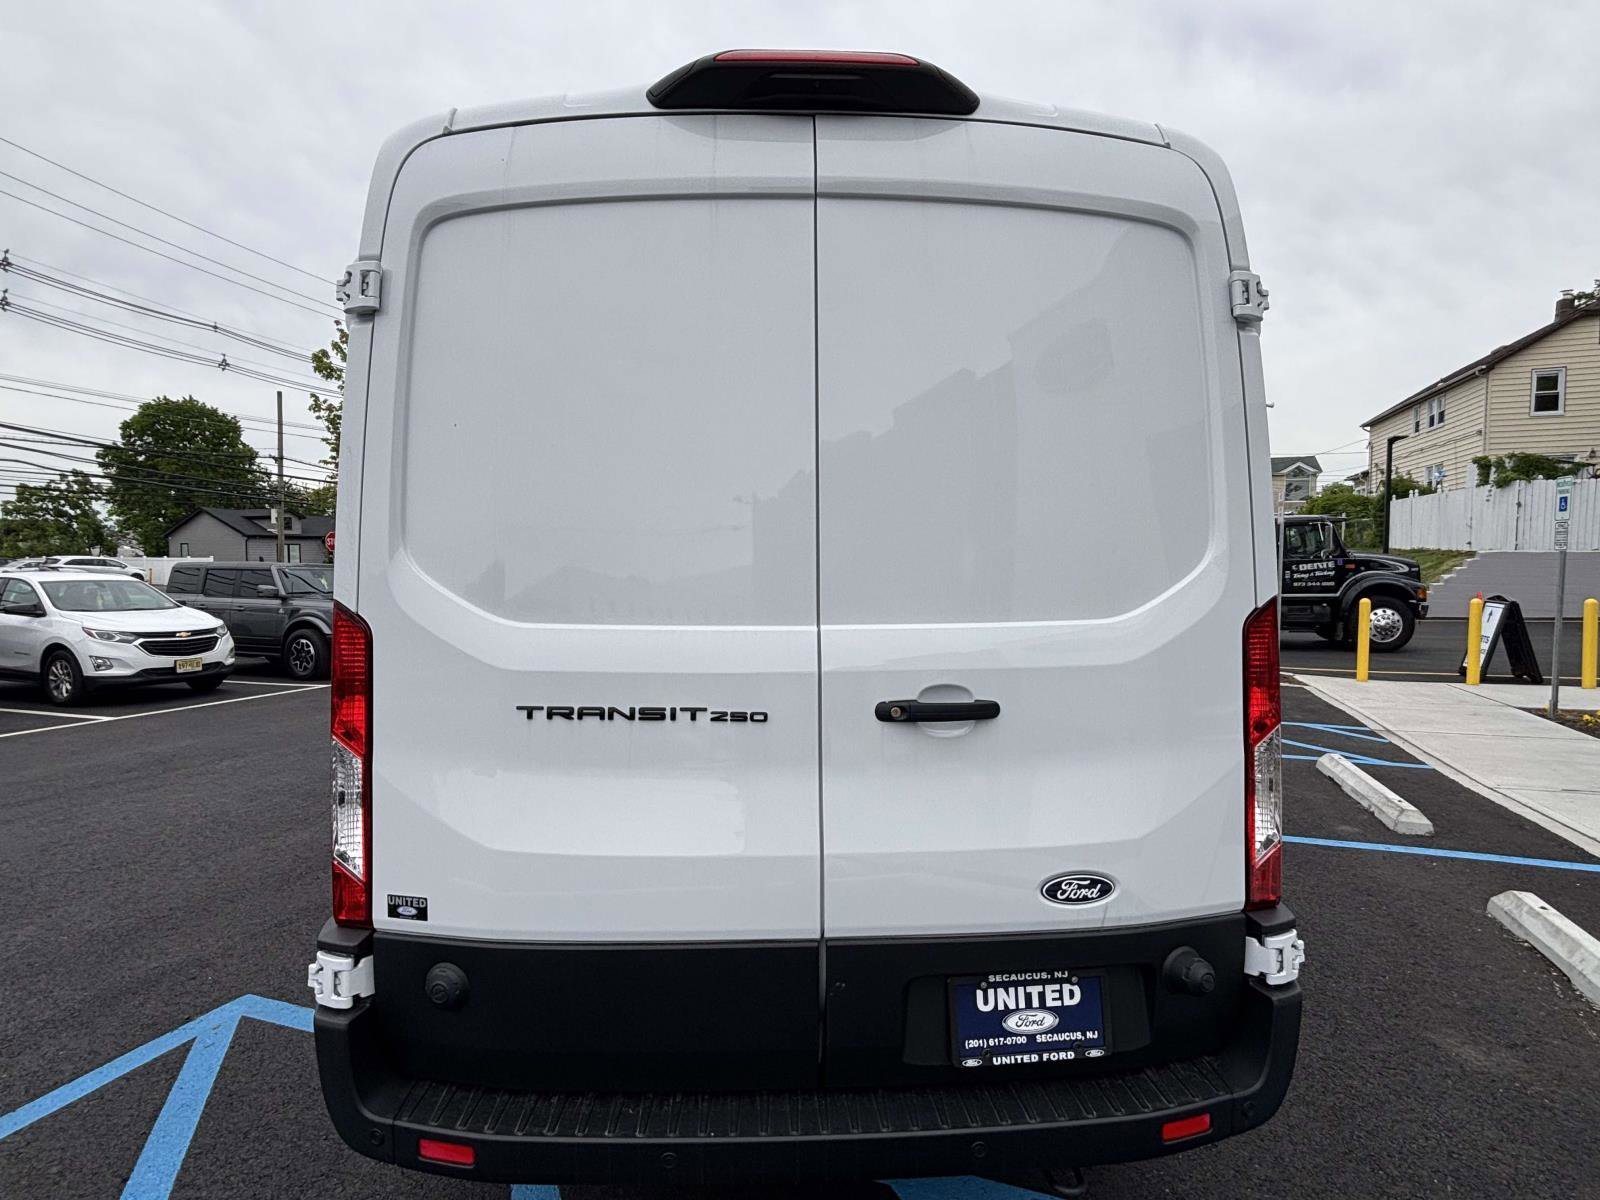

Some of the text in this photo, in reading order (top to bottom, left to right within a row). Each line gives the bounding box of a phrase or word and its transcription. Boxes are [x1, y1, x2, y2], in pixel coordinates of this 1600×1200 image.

[516, 705, 769, 723] TRANSIT 250
[1057, 880, 1102, 900] Ford
[388, 896, 426, 908] UNITED
[988, 970, 1069, 982] SECAUCUS, NJ
[975, 983, 1082, 1012] UNITED
[1015, 1014, 1046, 1029] Ford
[965, 1030, 1098, 1049] (201) 617-0700 SECAUCUS, NJ
[992, 1054, 1039, 1066] UNITED
[1042, 1051, 1075, 1062] FORD
